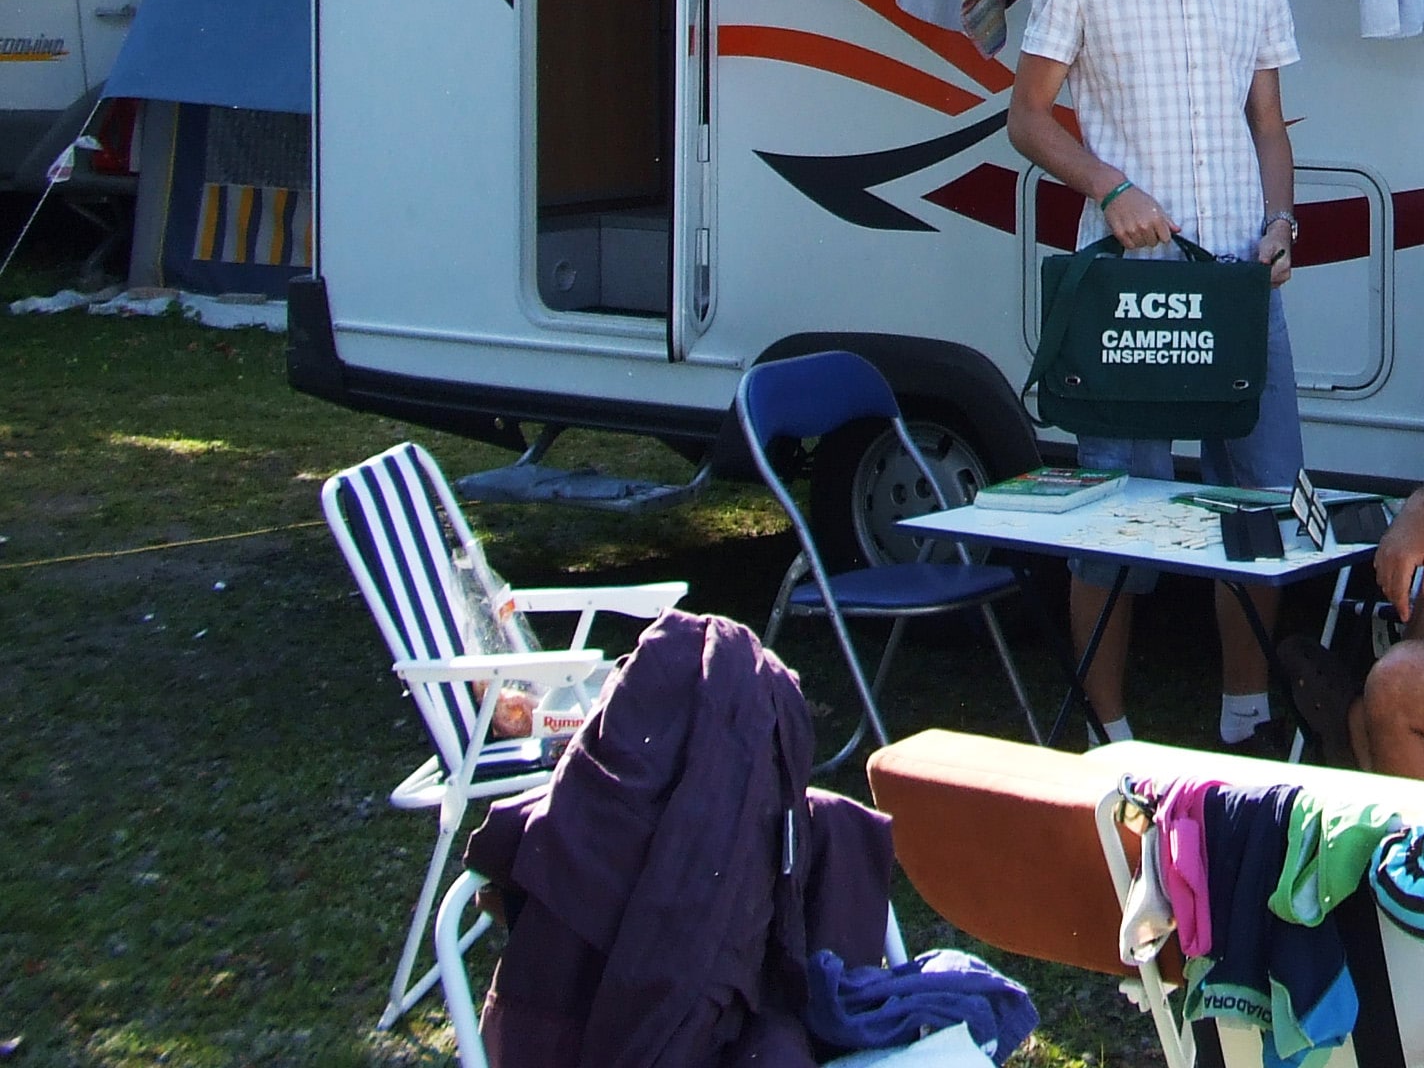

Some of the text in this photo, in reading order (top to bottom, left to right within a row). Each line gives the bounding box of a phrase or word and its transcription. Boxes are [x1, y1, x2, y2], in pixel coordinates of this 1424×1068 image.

[1114, 292, 1203, 320] ACSI
[1101, 330, 1215, 350] CAMPING
[1101, 349, 1214, 365] INSPECTION
[543, 715, 585, 733] Rumm
[1203, 995, 1273, 1024] DIADORA
